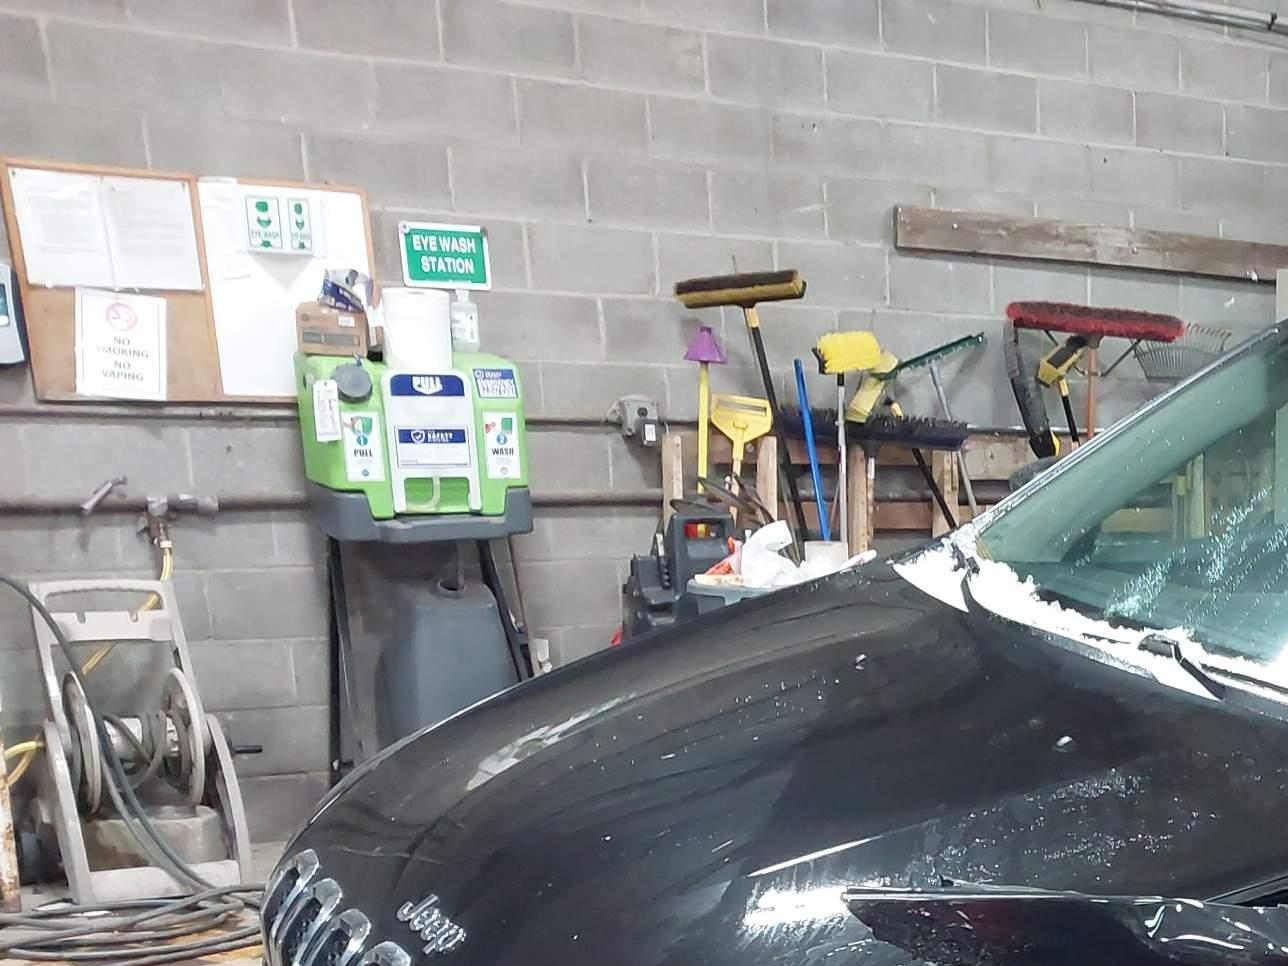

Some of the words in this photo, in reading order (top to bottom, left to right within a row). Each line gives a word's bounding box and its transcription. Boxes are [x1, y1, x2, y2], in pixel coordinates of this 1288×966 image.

[412, 234, 438, 252] EYE
[438, 235, 476, 254] WASH
[420, 255, 474, 274] STATION
[113, 336, 131, 346] NO
[96, 344, 149, 359] SMOKING
[114, 360, 131, 370] NO
[102, 369, 144, 382] VAPING
[353, 448, 374, 458] PULL
[491, 447, 514, 456] WASH
[397, 893, 467, 955] Jeep
